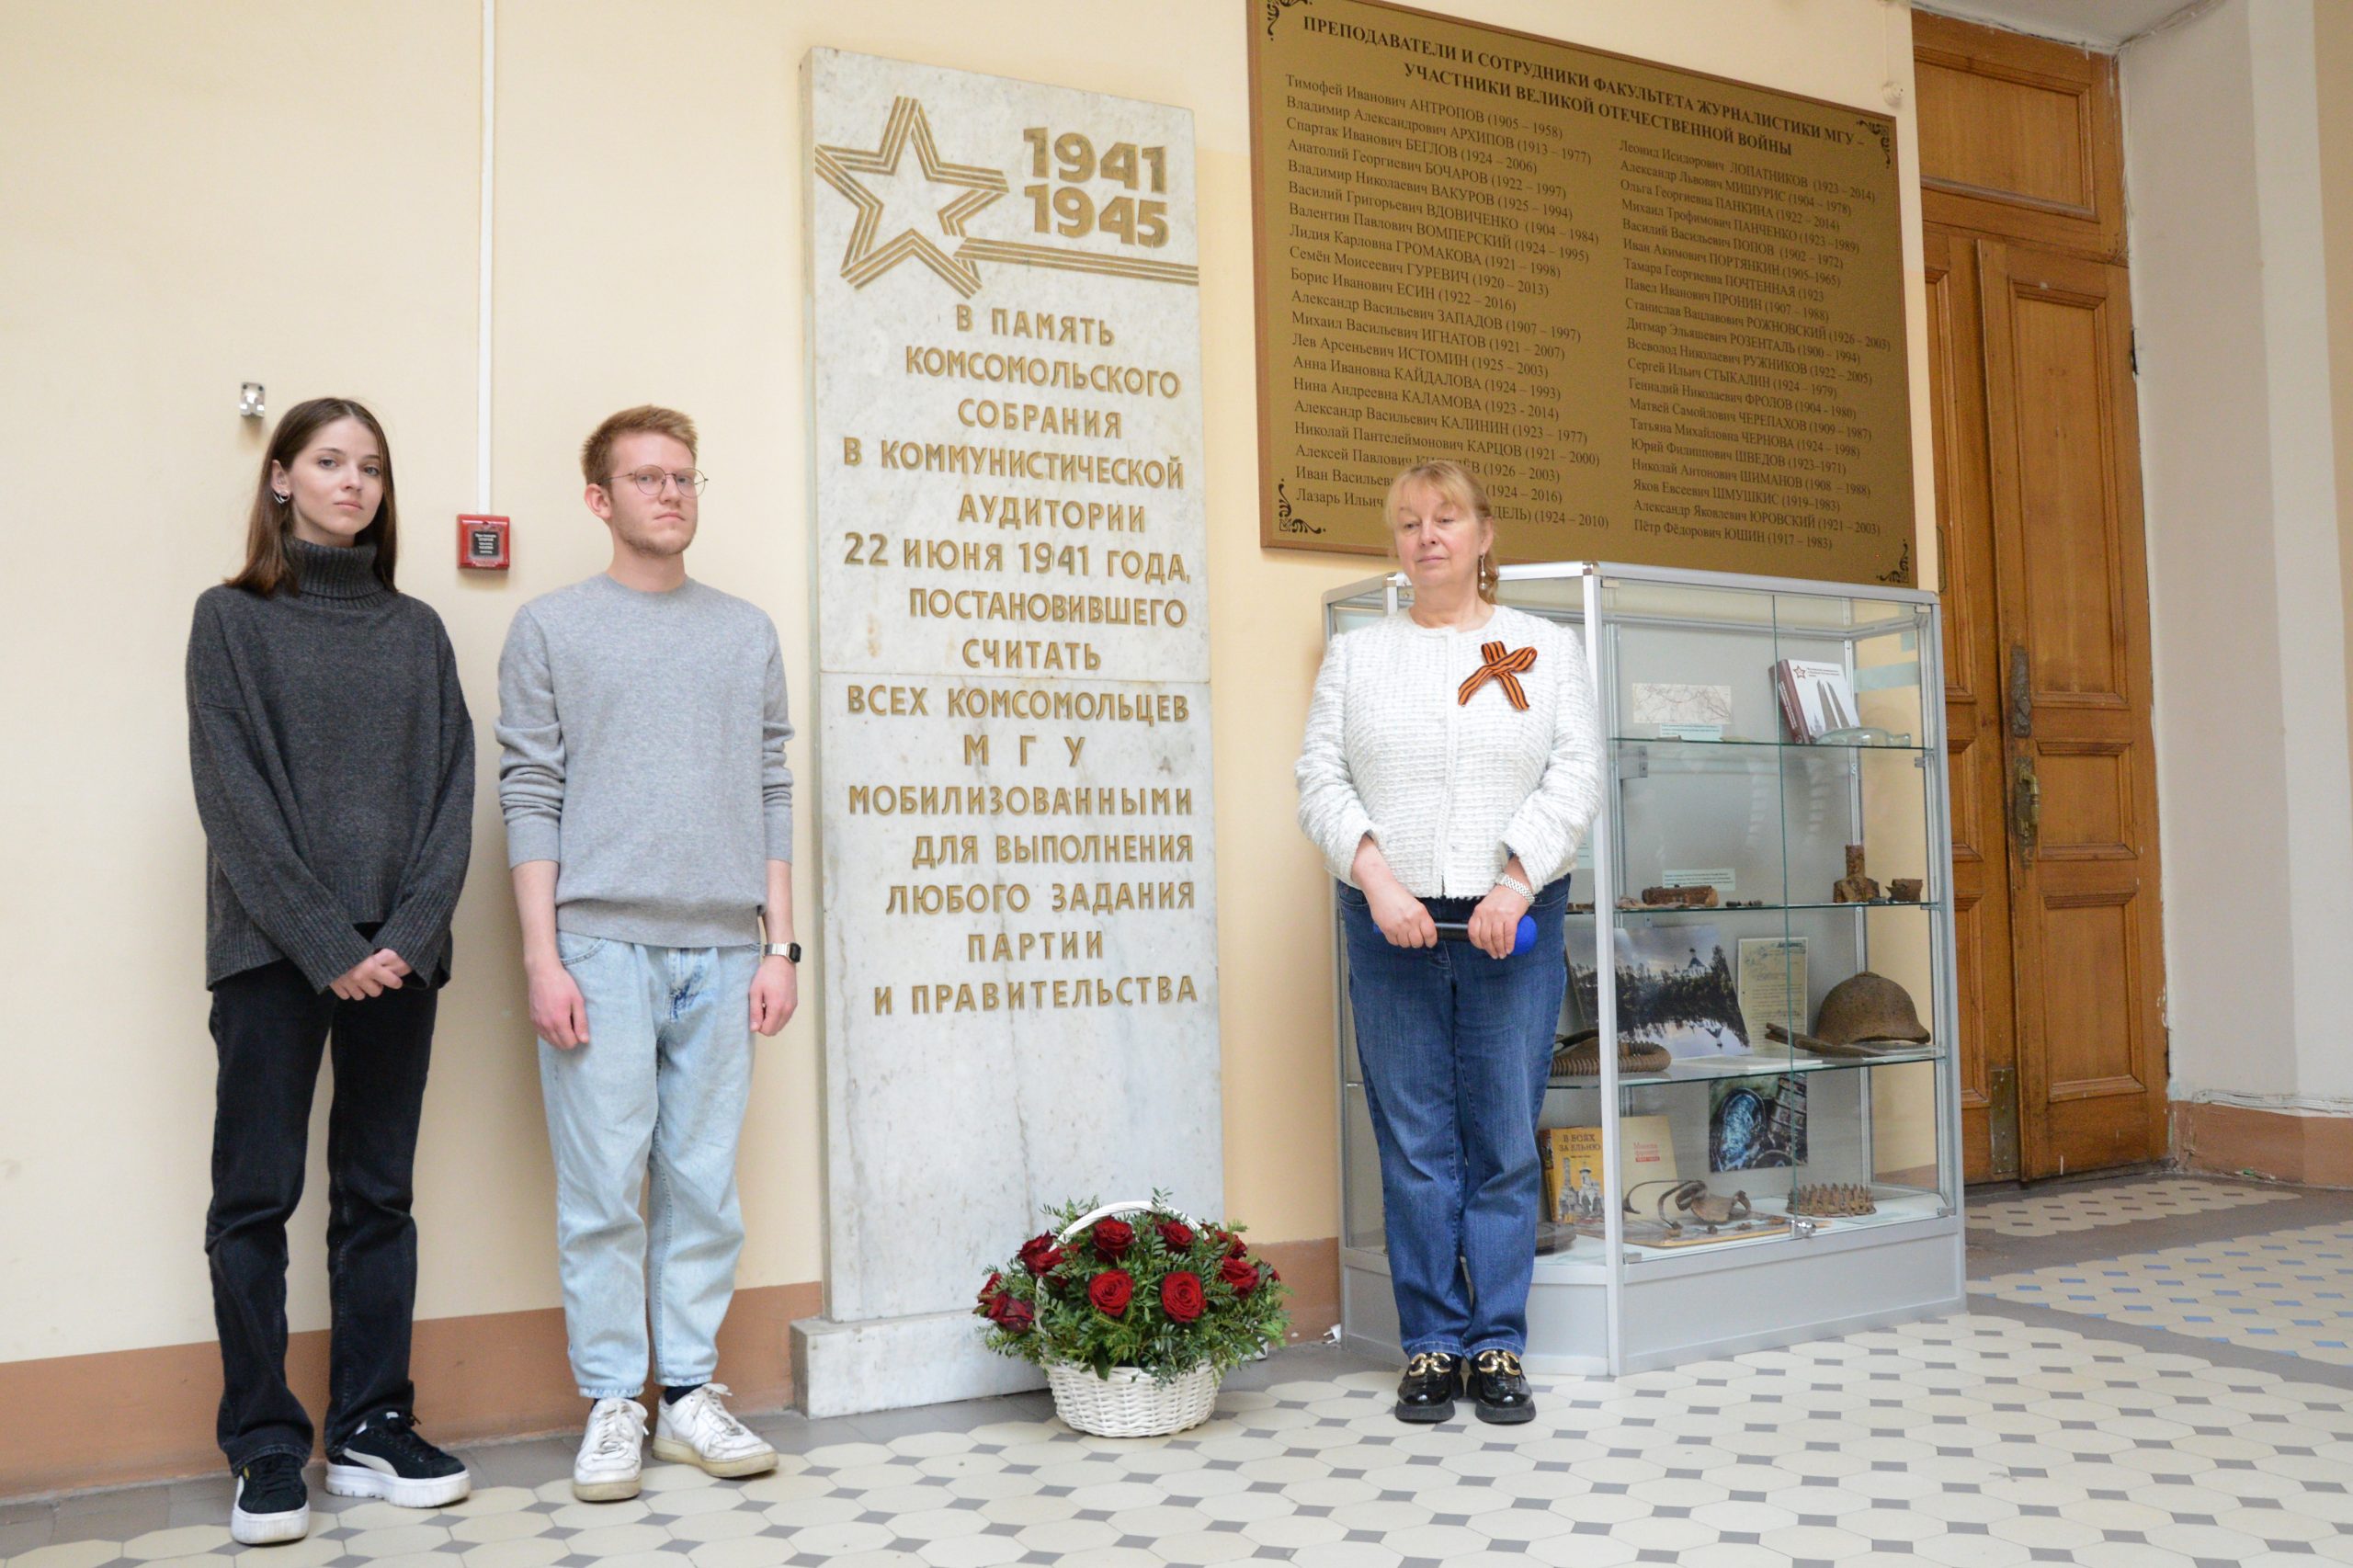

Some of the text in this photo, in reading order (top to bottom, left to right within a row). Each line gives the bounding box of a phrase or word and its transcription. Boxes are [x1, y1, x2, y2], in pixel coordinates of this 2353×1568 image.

[1303, 15, 1456, 61] ПРЕПОДАВАТЕЛИ
[1461, 48, 1472, 63] И
[1477, 51, 1589, 88] СОТРУДНИКИ
[1593, 77, 1693, 110] ФАКУЛЬТЕТА
[1697, 98, 1820, 138] ЖУРНАЛИСТИКИ
[1824, 127, 1853, 145] МГУ
[1285, 74, 1342, 96] Тимофей
[1347, 85, 1405, 108] Иванович
[1409, 98, 1483, 123] АНТРОПОВ
[1487, 114, 1518, 129] (1905
[1533, 121, 1563, 139] 1958)
[1404, 62, 1791, 155] УЧАСТНИКИ ВЕЛИКОЙ ОТЕЧЕСТВЕННОЙ ВОЙНЫ
[1023, 126, 1168, 192] 1941
[1286, 116, 1338, 137] Спартак
[1342, 125, 1401, 148] Иванович
[1405, 137, 1457, 158] БЕГЛОВ
[1461, 149, 1492, 164] (1924
[1506, 156, 1537, 175] 2006)
[1288, 158, 1351, 184] Владимир
[1356, 170, 1427, 194] Николаевич
[1431, 183, 1494, 205] ВАКУРОВ
[1497, 196, 1529, 211] (1925
[1543, 203, 1573, 221] 1994)
[1619, 140, 1659, 158] Леонид
[1662, 147, 1723, 170] Исидорович
[1730, 161, 1808, 187] ЛОПАТНИКОВ
[1813, 180, 1838, 193] (1923
[1849, 186, 1875, 203] 2014)
[1023, 185, 1170, 247] 1945
[1289, 201, 1349, 223] Валентин
[1353, 211, 1412, 233] Павлович
[1415, 222, 1511, 249] ВОМПЕРСКИЙ
[1514, 240, 1545, 255] (1924
[1560, 246, 1588, 263] 1995)
[1621, 198, 1663, 216] Михаил
[1666, 206, 1731, 229] Трофимович
[1733, 219, 1797, 240] ПАНЧЕНКО
[1799, 233, 1824, 246] (1923
[1623, 237, 1650, 253] Иван
[1654, 244, 1706, 262] Акимович
[1709, 252, 1779, 275] ПОРТЯНКИН
[1623, 256, 1824, 301] Тамара Георгиевна ПОЧТЕННАЯ (1923
[1290, 267, 1328, 285] Борис
[1333, 272, 1392, 293] Иванович
[1397, 281, 1434, 300] ЕСИН
[1438, 289, 1470, 305] (1922
[1484, 295, 1516, 312] 2016)
[956, 305, 1115, 346] В ПАМЯТЬ
[1290, 290, 1358, 312] Александр
[1363, 298, 1433, 320] Васильевич
[1437, 309, 1502, 330] ЗАПАДОВ
[1506, 320, 1536, 334] (1907
[1552, 325, 1581, 343] 1997)
[1625, 297, 1681, 316] Станислав
[1683, 306, 1744, 326] Вацлавович
[1746, 316, 1825, 339] РОЖНОВСКИЙ
[1828, 331, 1854, 344] (1926
[1865, 335, 1889, 349] 2003)
[906, 346, 1181, 399] КОМСОМОЛЬСКОГО
[1291, 332, 1316, 347] Лев
[1320, 336, 1393, 358] Арсеньевич
[1397, 346, 1468, 367] ИСТОМИН
[1471, 357, 1503, 371] (1925
[1517, 361, 1548, 379] 2003)
[957, 399, 1122, 438] СОБРАНИЯ
[1293, 376, 1326, 392] Нина
[1330, 381, 1398, 401] Андреевна
[1402, 389, 1481, 410] КАЛАМОВА
[1484, 400, 1516, 415] (1923
[1528, 404, 1559, 421] 2014)
[1629, 397, 1669, 413] Матвей
[1671, 403, 1735, 422] Самойлович
[1738, 411, 1806, 430] ЧЕРЕПАХОВ
[1809, 422, 1836, 434] (1909
[1847, 426, 1871, 440] 1987)
[1293, 399, 1362, 421] Александр
[1366, 406, 1437, 426] Васильевич
[1441, 415, 1508, 435] КАЛИНИН
[1512, 424, 1543, 438] (1923
[1558, 428, 1587, 445] 1977)
[844, 437, 1185, 489] В КОММУНИСТИЧЕСКОЙ
[1631, 437, 1663, 453] Юрий
[1665, 442, 1732, 460] Филиппович
[1734, 449, 1785, 466] ШВЕДОВ
[958, 494, 1145, 532] АУДИТОРИИ
[1633, 478, 1659, 492] Яков
[1662, 481, 1709, 497] Евсеевич
[1712, 486, 1777, 504] ШМУШКИС
[1633, 499, 1689, 518] Александр
[1693, 505, 1746, 520] Яковлевич
[1749, 510, 1814, 528] ЮРОВСКИЙ
[1817, 518, 1842, 530] (1921
[1855, 521, 1880, 535] 2003)
[1633, 518, 1660, 535] Пётр
[1663, 521, 1721, 539] Фёдорович
[1724, 527, 1764, 542] ЮШИН
[1768, 532, 1794, 544] (1917
[1807, 536, 1832, 550] 1983)
[844, 533, 1191, 584] 22 ИЮНЯ 1941 ГОДА,
[909, 589, 1187, 628] ПОСТАНОВИВШЕГО
[962, 639, 1101, 671] СЧИТАТЬ
[848, 686, 1189, 725] ВСЕХ КОМСОМОЛЬЦЕВ
[849, 786, 1192, 815] МОБИЛИЗОВАННЫМИ
[913, 835, 1194, 868] ДЛЯ ВЫПОЛНЕНИЯ
[886, 881, 1195, 915] ЛЮБОГО ЗАДАНИЯ
[969, 932, 1102, 961] ПАРТИИ
[874, 976, 1198, 1015] И ПРАВИТЕЛЬСТВА
